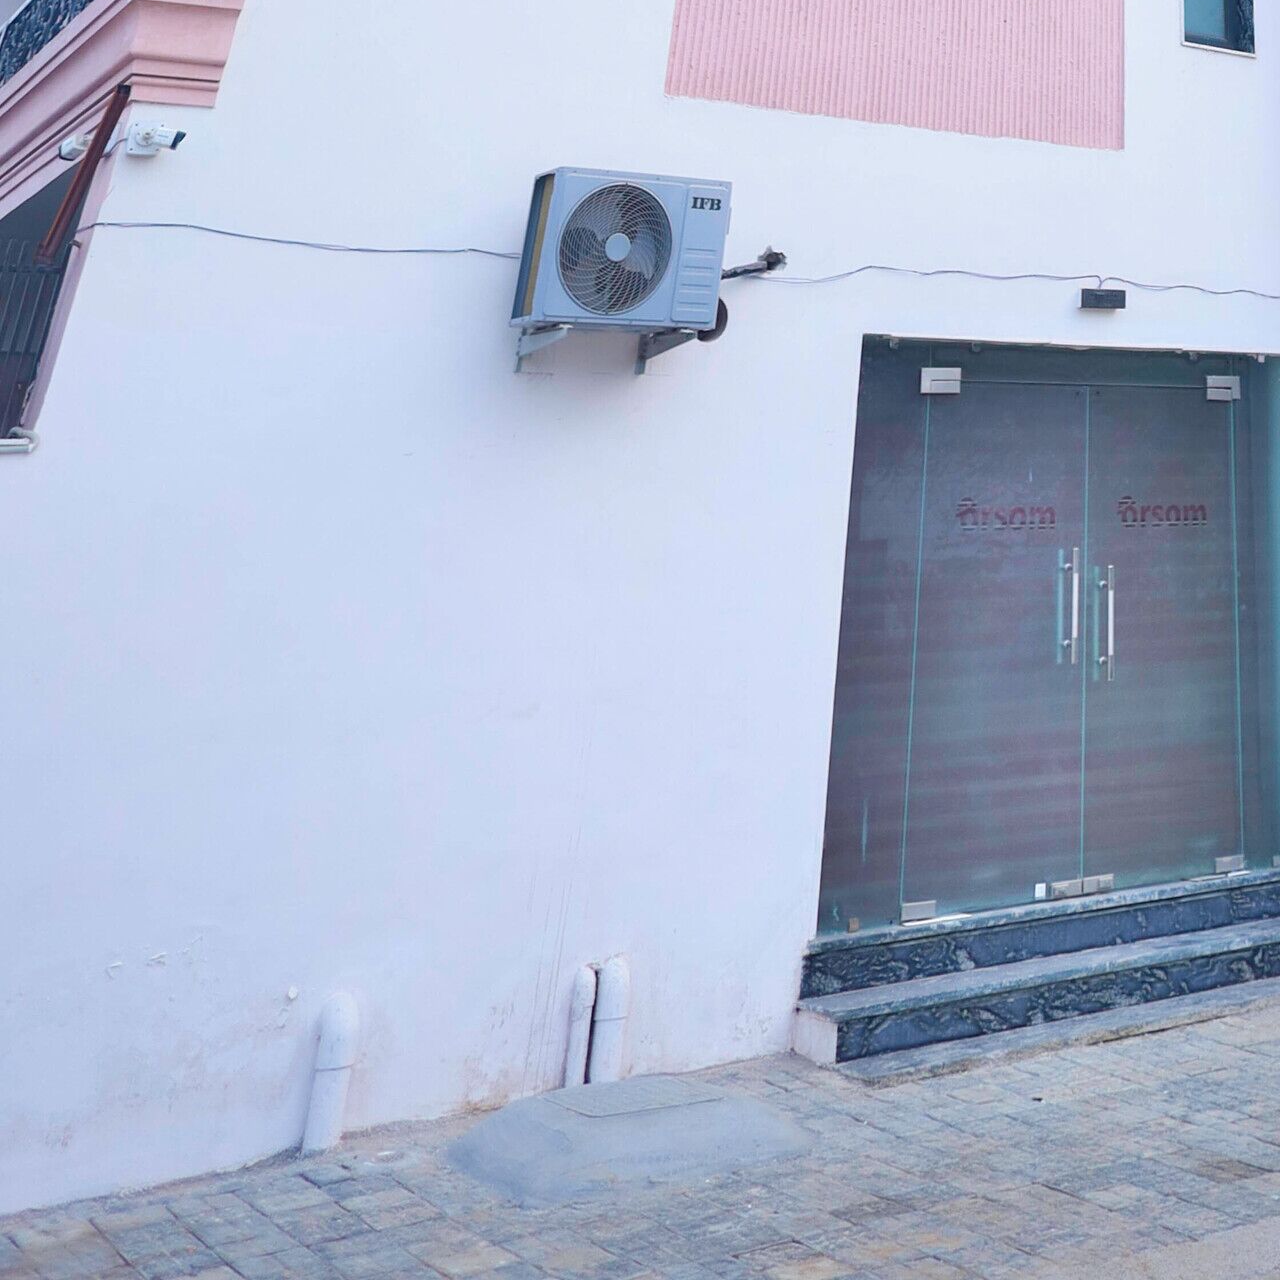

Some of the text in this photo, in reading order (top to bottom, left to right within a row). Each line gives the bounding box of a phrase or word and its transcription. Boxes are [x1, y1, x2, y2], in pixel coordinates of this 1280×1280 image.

[691, 196, 722, 211] IFB
[956, 500, 1057, 531] orsom
[1118, 498, 1208, 528] orsom
